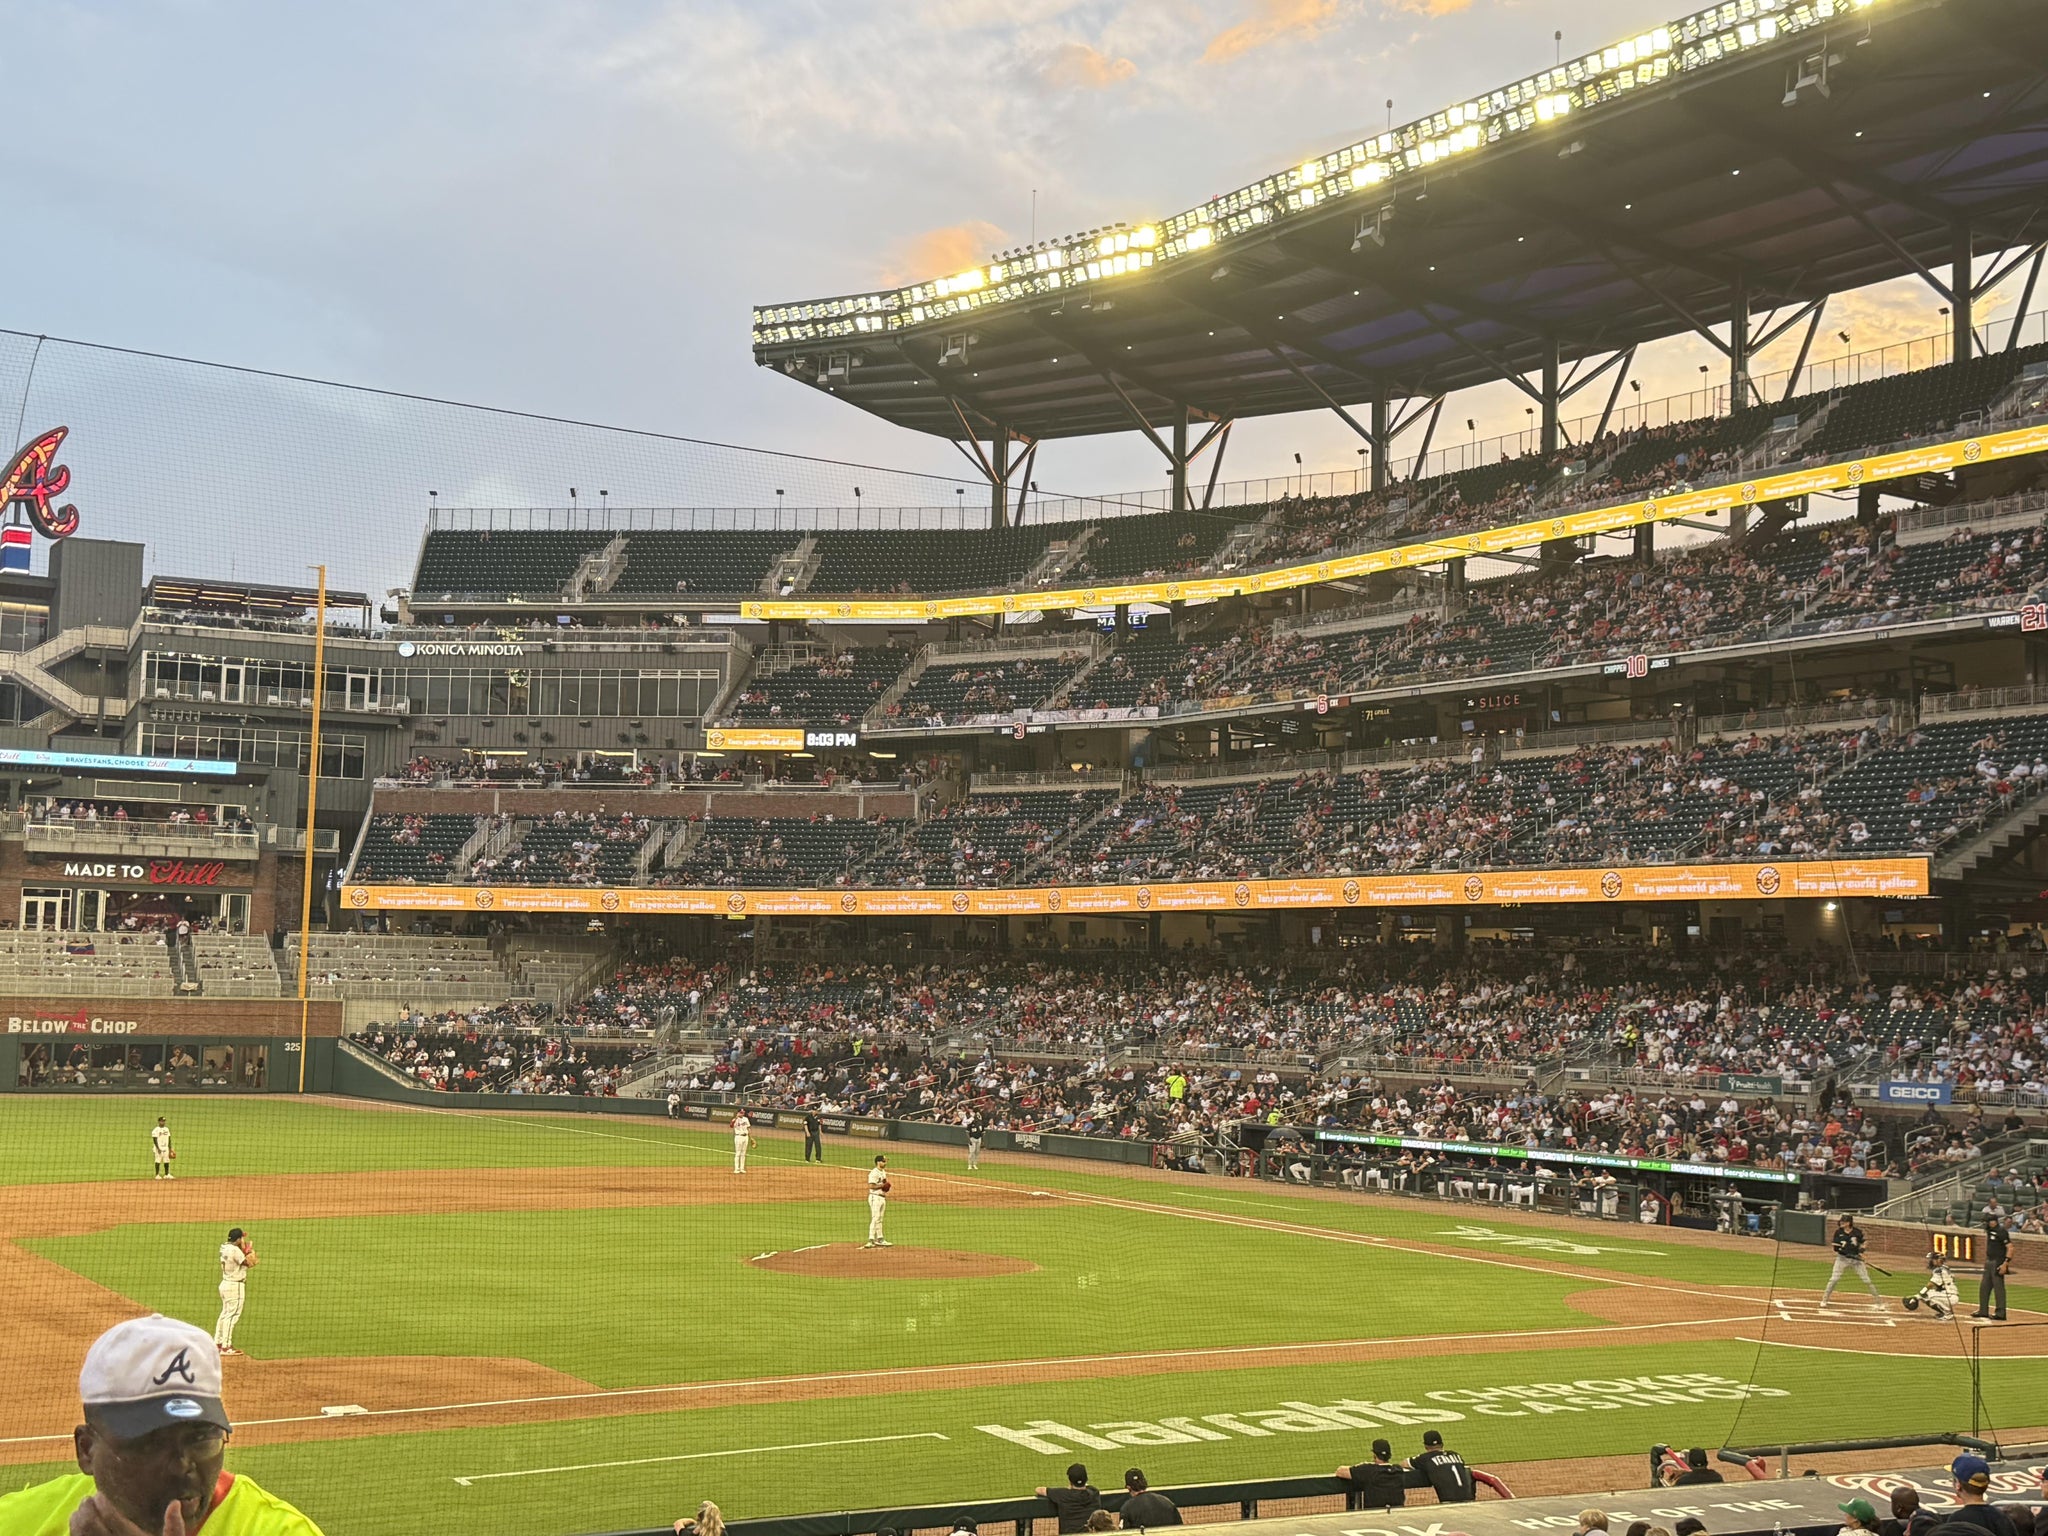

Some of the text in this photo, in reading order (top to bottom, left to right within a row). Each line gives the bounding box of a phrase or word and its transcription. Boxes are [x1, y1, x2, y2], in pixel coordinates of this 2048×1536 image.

[1988, 602, 2048, 632] WARREN 21
[416, 644, 524, 656] KONICA MINOLTA
[1626, 654, 1647, 678] 10
[1316, 694, 1328, 714] 6
[1479, 695, 1520, 708] SLICE
[1365, 710, 1374, 720] 71
[1013, 721, 1025, 740] 3
[806, 733, 857, 747] 8:03 PM
[64, 860, 225, 885] MADE TO Chill
[1634, 883, 1654, 894] Turn
[1657, 885, 1675, 896] your
[1676, 881, 1706, 893] world
[1709, 880, 1742, 895] yellow
[1794, 878, 1816, 890] Turn
[1820, 881, 1844, 892] your
[1846, 877, 1876, 889] world
[1880, 876, 1918, 891] yellow
[1493, 886, 1588, 899] Turn your world yellow
[8, 1017, 69, 1034] BELOW
[91, 1018, 138, 1034] CHOP
[285, 1042, 301, 1051] 325
[1736, 1082, 1772, 1091] PruittHealth
[1889, 1087, 1940, 1099] GEICO
[1574, 1155, 1596, 1164] Georgia
[1598, 1158, 1629, 1167] Grown.com
[1724, 1169, 1748, 1178] Georgia
[1750, 1171, 1784, 1181] Grown.com
[153, 1347, 195, 1386] A
[1424, 1373, 1739, 1403] CHEROKEE
[1471, 1384, 1791, 1417] CASINOS
[1451, 1465, 1463, 1487] 1
[1510, 1499, 1804, 1529] HOE OF THE
